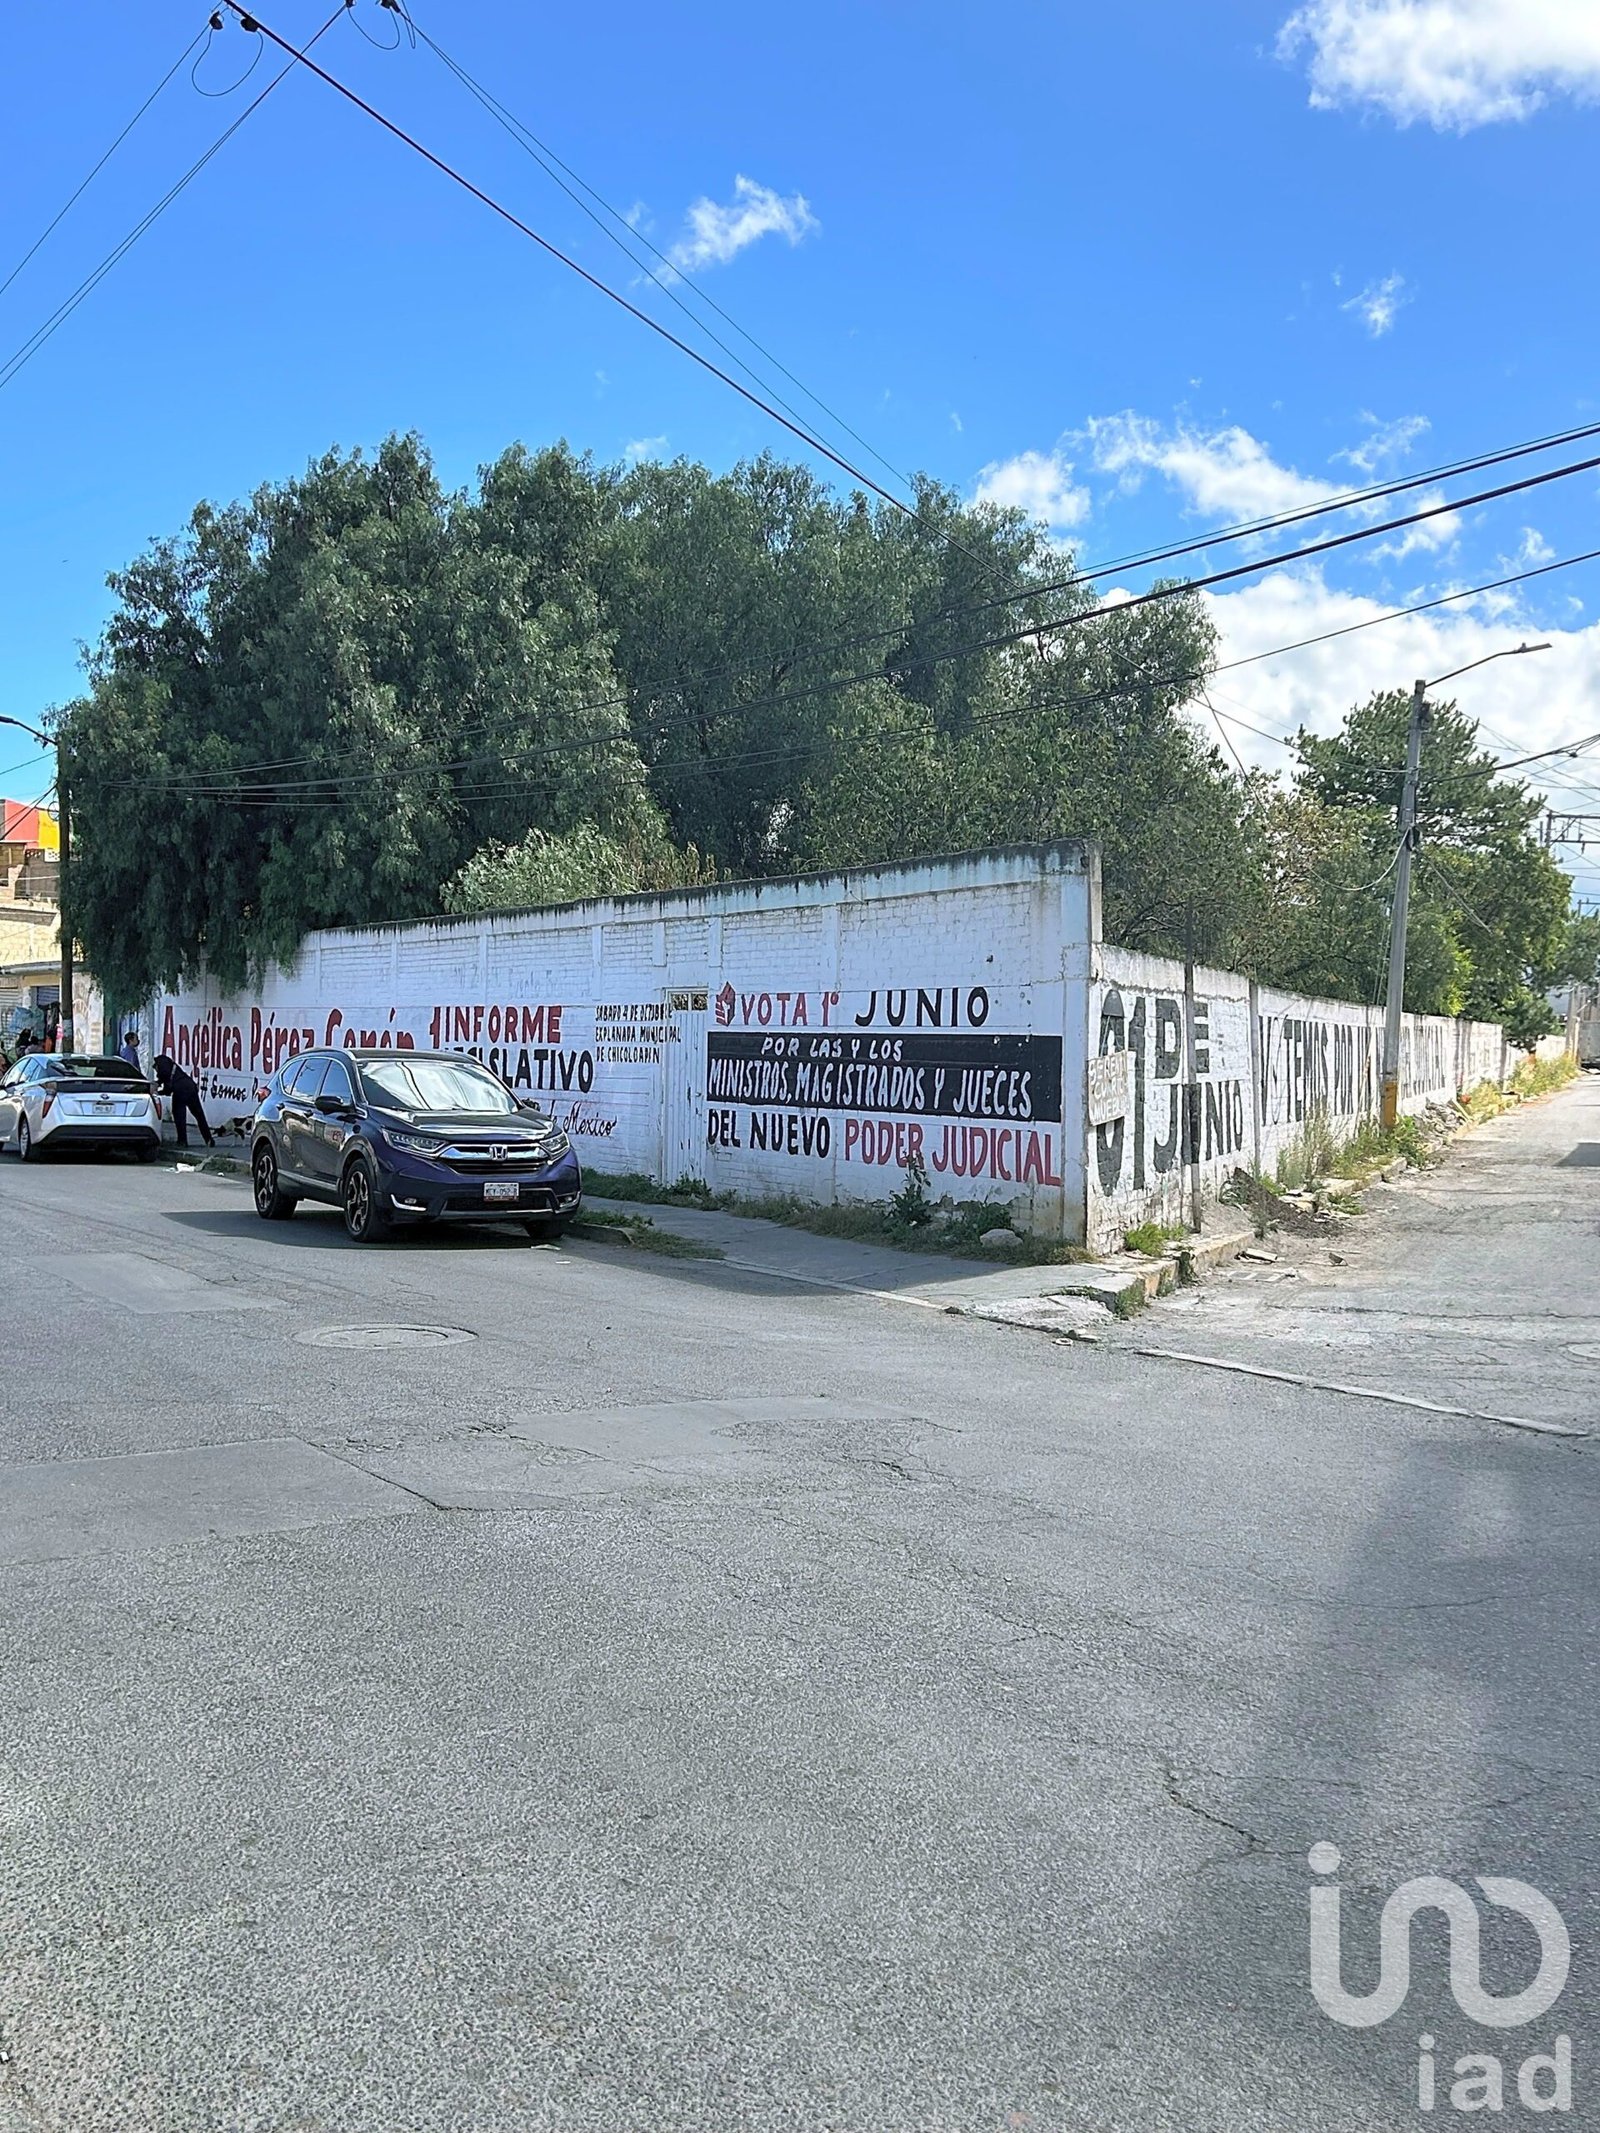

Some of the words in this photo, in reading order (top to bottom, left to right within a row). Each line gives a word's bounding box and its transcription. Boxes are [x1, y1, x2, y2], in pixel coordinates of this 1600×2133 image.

[445, 1005, 562, 1043] INFORME
[630, 1004, 639, 1022] DE
[741, 992, 808, 1027] VOTA
[854, 986, 989, 1027] JUNIO
[162, 1005, 242, 1080] Angélica
[761, 1036, 800, 1057] POR
[809, 1038, 842, 1058] LAS
[851, 1038, 860, 1059] Y
[869, 1039, 903, 1062] LOS
[1154, 998, 1209, 1079] DE
[795, 1061, 925, 1111] MAGISTRADOS
[934, 1067, 945, 1109] Y
[952, 1069, 1032, 1118] JUECES
[707, 1108, 741, 1148] DEL
[750, 1111, 831, 1158] NUEVO
[845, 1118, 925, 1170] PODER
[931, 1125, 1064, 1187] JUDICIAL
[1154, 1080, 1243, 1173] JUNIO
